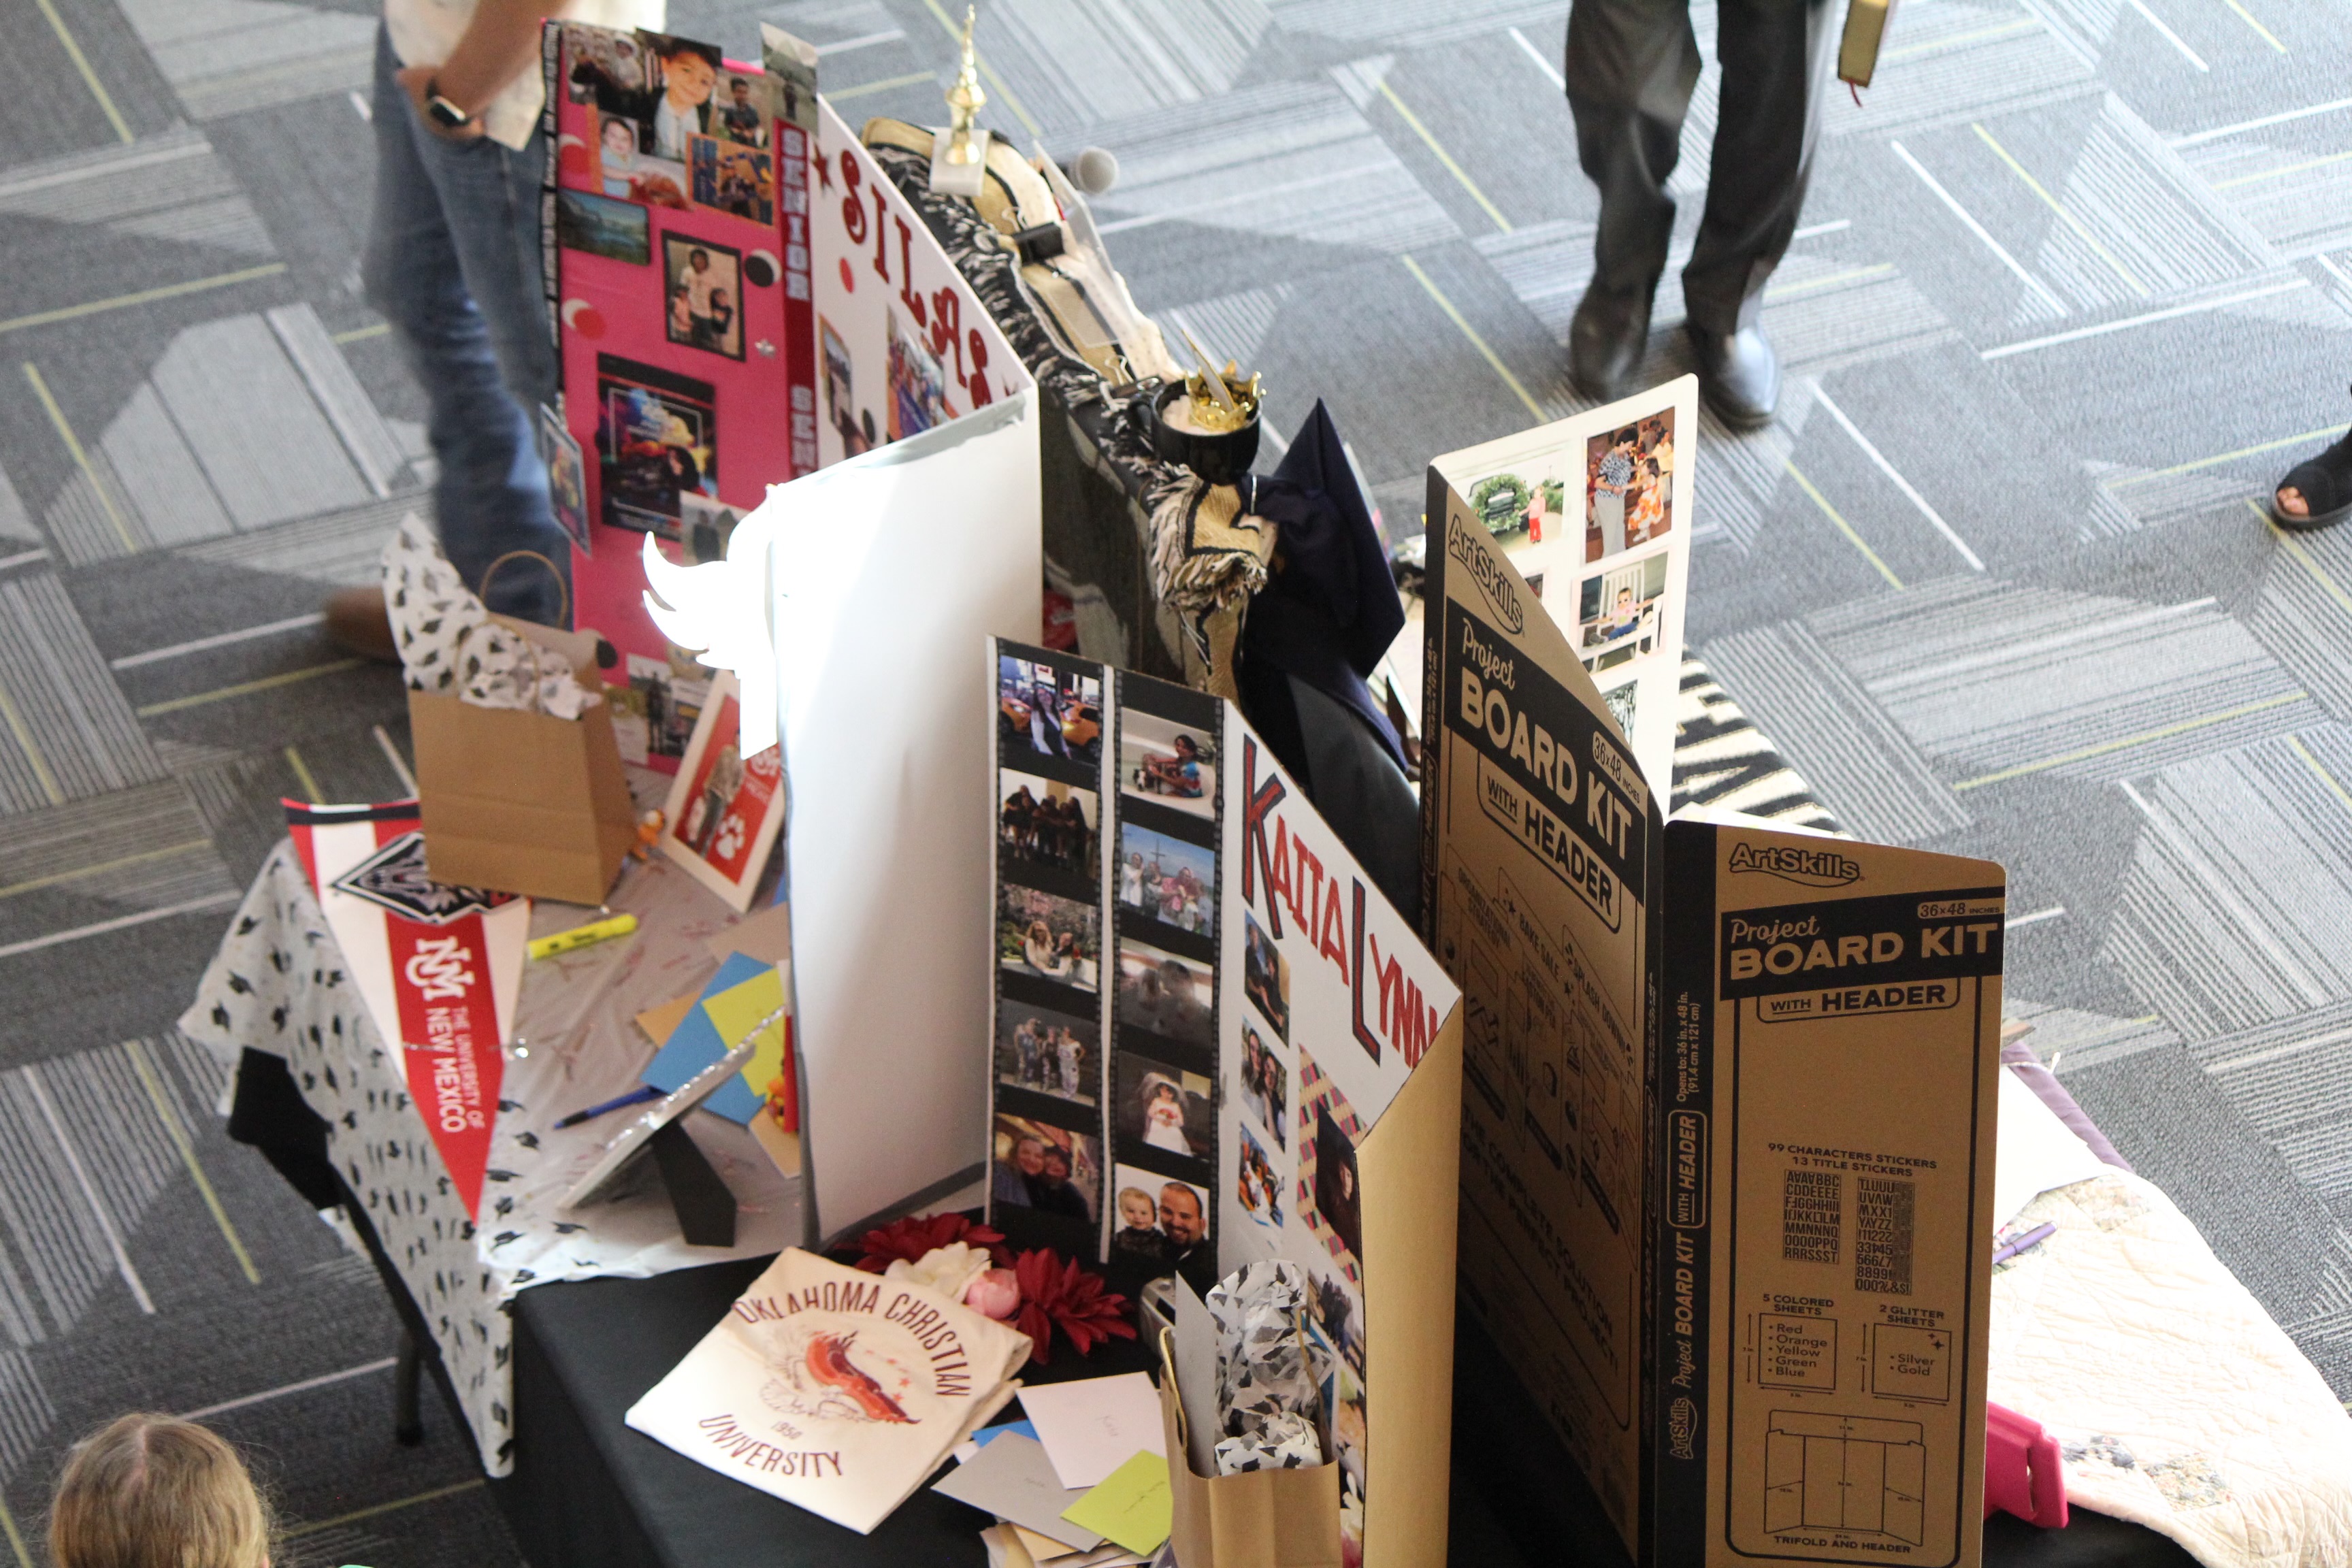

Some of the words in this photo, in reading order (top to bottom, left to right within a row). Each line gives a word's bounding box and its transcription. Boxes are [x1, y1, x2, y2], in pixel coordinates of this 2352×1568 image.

[1449, 514, 1523, 632] ArtSkills
[1463, 617, 1516, 689] Project
[1460, 666, 1578, 805] BOARD
[1587, 770, 1633, 861] KIT
[1487, 774, 1518, 818] WITH
[1524, 799, 1612, 918] HEADER
[1729, 842, 1861, 882] ArtSkills
[1969, 905, 2001, 915] INCHES
[1730, 915, 1820, 945] Project
[1520, 913, 1540, 953] BAKE
[1541, 943, 1559, 983] SALE
[1730, 932, 1904, 980] BOARD
[1921, 922, 1998, 959] KIT
[1677, 991, 1688, 1003] in.
[1771, 997, 1812, 1012] WITH
[1821, 984, 1946, 1012] HEADER
[451, 1007, 471, 1031] THE
[1677, 1006, 1688, 1019] 48
[1689, 1002, 1701, 1021] cm)
[425, 1007, 457, 1054] NEW
[1677, 1028, 1688, 1040] in.
[1688, 1023, 1700, 1041] 121
[1677, 1040, 1688, 1055] 36
[1690, 1051, 1699, 1066] cm
[455, 1033, 481, 1107] UNIVERSITY
[1688, 1066, 1700, 1093] (91.4
[431, 1057, 468, 1134] MEXICO
[1676, 1071, 1689, 1102] Opens
[466, 1109, 485, 1129] OF
[1678, 1115, 1697, 1190] HEADER
[1767, 1142, 1785, 1152] 99
[1787, 1144, 1873, 1161] CHARACTERS
[1876, 1154, 1938, 1169] STICKERS
[1792, 1156, 1809, 1166] 13
[1812, 1158, 1848, 1170] TITLE
[1852, 1162, 1913, 1177] STICKERS
[1678, 1193, 1689, 1222] WITH
[1488, 1141, 1553, 1243] COMPLETE
[1556, 1235, 1613, 1338] SOLUTION
[1509, 1193, 1560, 1279] PERFECT
[1676, 1231, 1695, 1268] KIT
[1676, 1269, 1695, 1336] BOARD
[1763, 1294, 1770, 1303] 5
[1774, 1294, 1834, 1307] COLORED
[1774, 1304, 1822, 1316] SHEETS
[1879, 1305, 1886, 1313] 2
[1890, 1306, 1945, 1320] GLITTER
[1776, 1324, 1803, 1335] Red
[1887, 1315, 1936, 1327] SHEETS
[732, 1281, 881, 1324] OKLAHOMA
[884, 1292, 973, 1397] CHRISTIAN
[1776, 1335, 1828, 1350] Orange
[1776, 1345, 1821, 1357] Yellow
[1672, 1339, 1693, 1389] Project
[1776, 1356, 1817, 1367] Green
[1776, 1367, 1806, 1377] Blue
[1897, 1365, 1931, 1376] Gold
[1898, 1353, 1936, 1365] Silver
[1670, 1396, 1695, 1460] ArtSkills
[698, 1413, 844, 1478] UNIVERSITY
[1774, 1535, 1828, 1547] TRIFOLD
[1831, 1540, 1858, 1550] AND
[1862, 1541, 1911, 1553] HEADER
